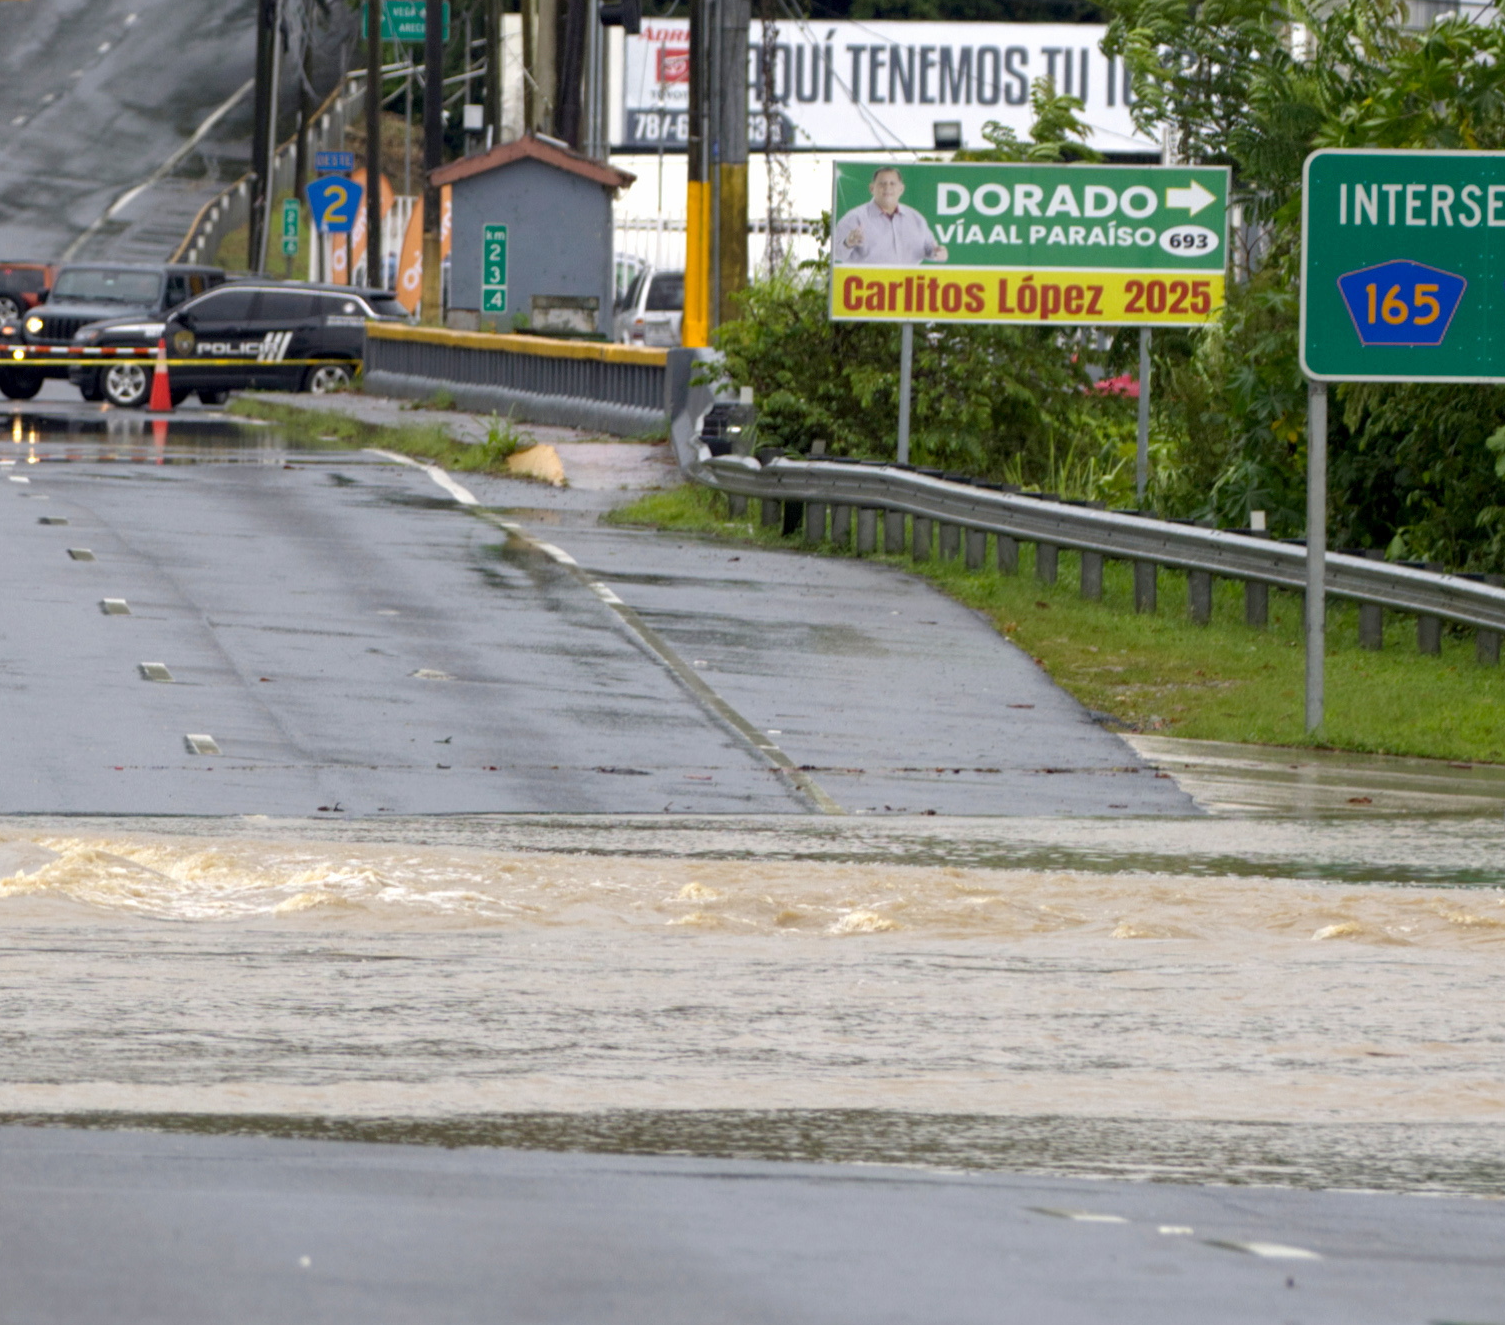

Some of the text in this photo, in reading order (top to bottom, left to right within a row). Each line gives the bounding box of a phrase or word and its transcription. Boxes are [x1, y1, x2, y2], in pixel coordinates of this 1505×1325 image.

[846, 44, 1030, 106] TENEMOS
[323, 185, 348, 222] 2
[936, 182, 1158, 220] DORADO
[486, 231, 506, 240] km
[489, 243, 501, 261] 2
[934, 219, 1209, 249] VÍA AL PARAÍSO 693
[489, 266, 501, 283] 3
[843, 275, 1212, 320] Carlitos López 2025
[1365, 283, 1440, 325] 165
